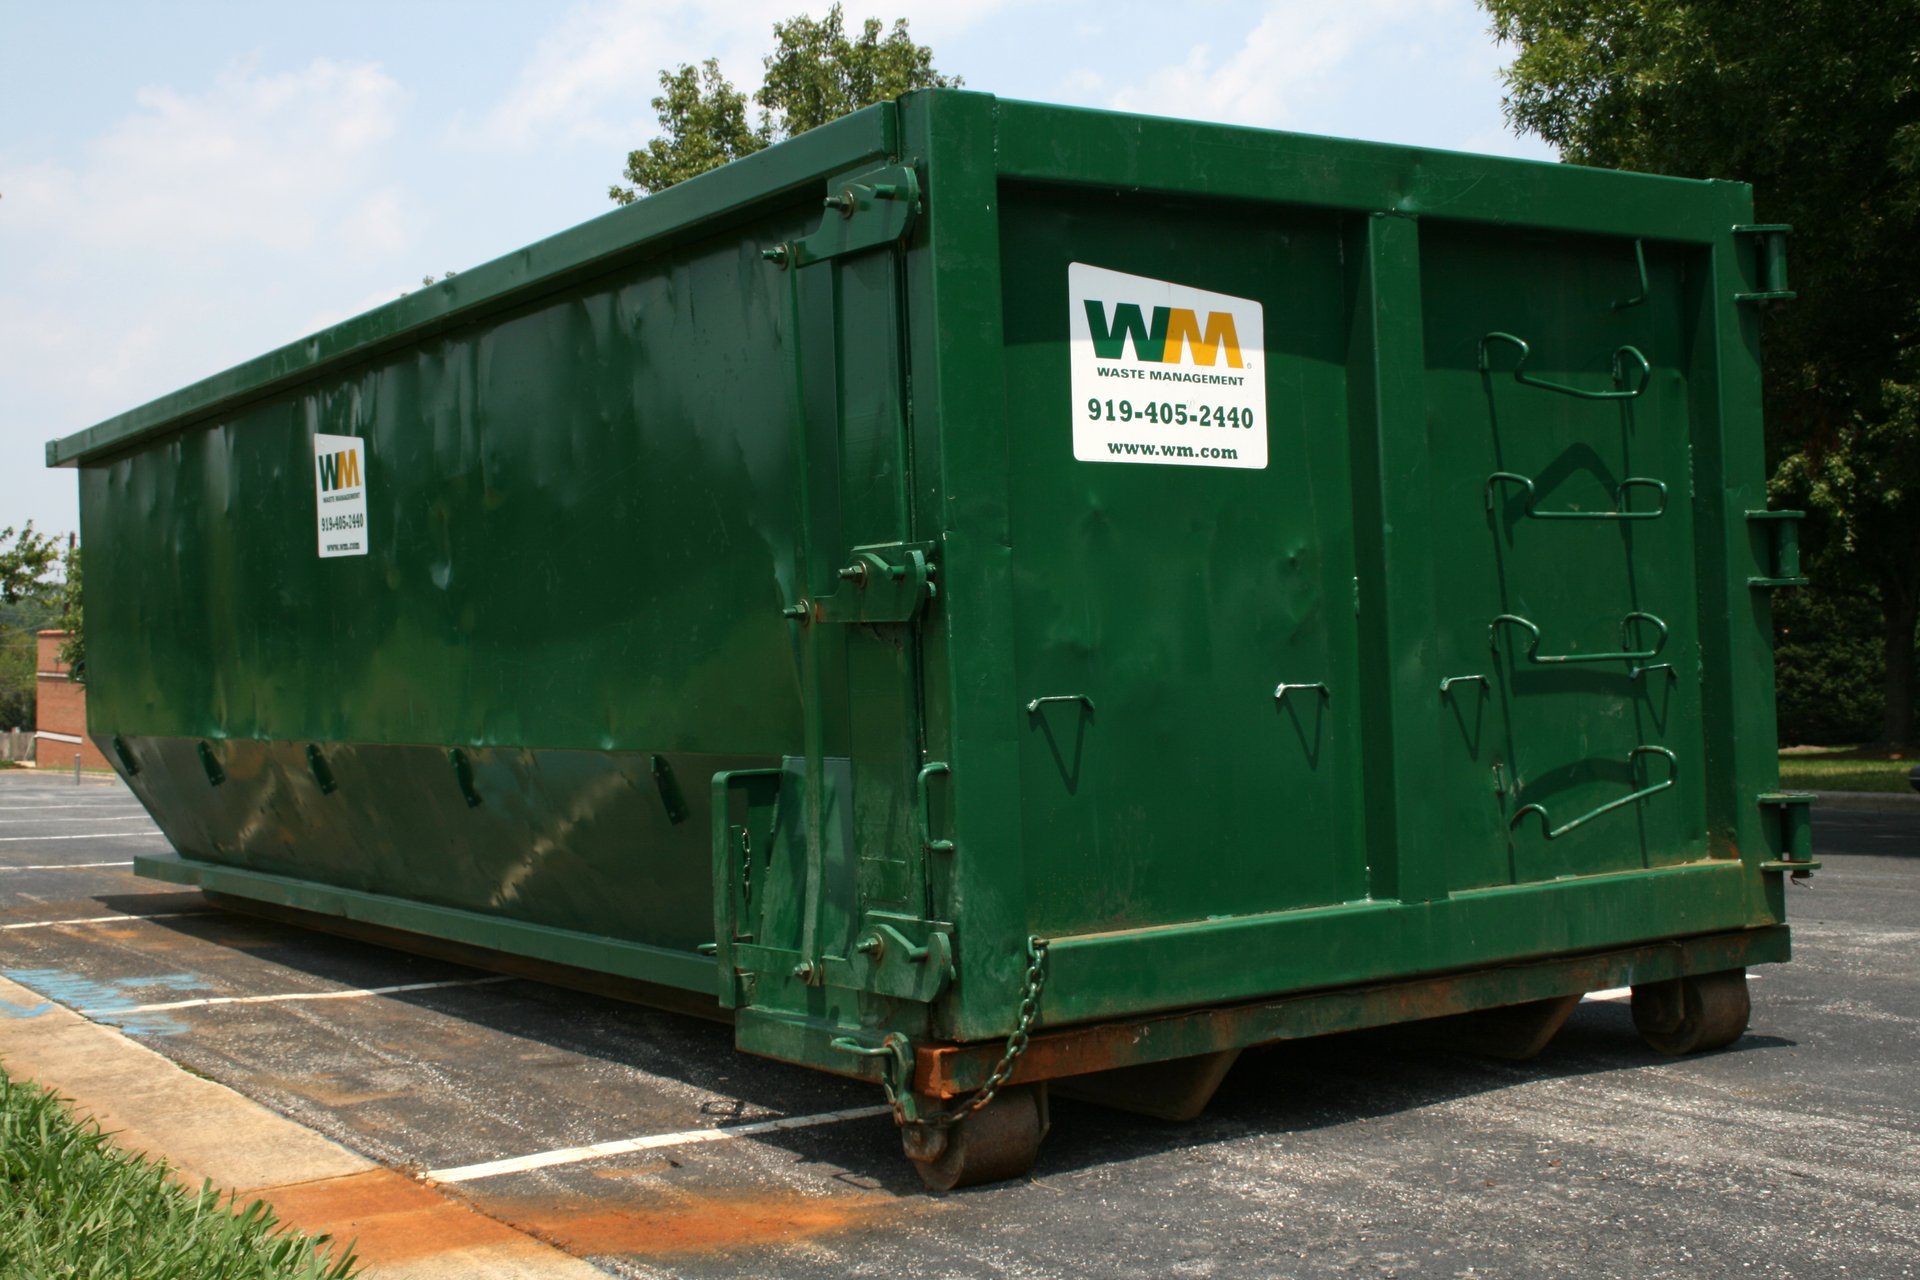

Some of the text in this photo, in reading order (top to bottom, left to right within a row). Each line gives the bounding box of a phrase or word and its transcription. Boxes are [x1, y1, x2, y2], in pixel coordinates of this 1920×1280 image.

[1083, 299, 1244, 369] WM
[1097, 367, 1244, 386] WASTE MANAGEMENT
[1088, 398, 1254, 429] 919-405-2440
[1107, 442, 1238, 460] www.wm.com
[318, 448, 360, 492] WM
[335, 492, 360, 502] MANAGEMENT
[321, 513, 363, 532] 919-405-2440
[326, 542, 360, 552] www.wm.com
